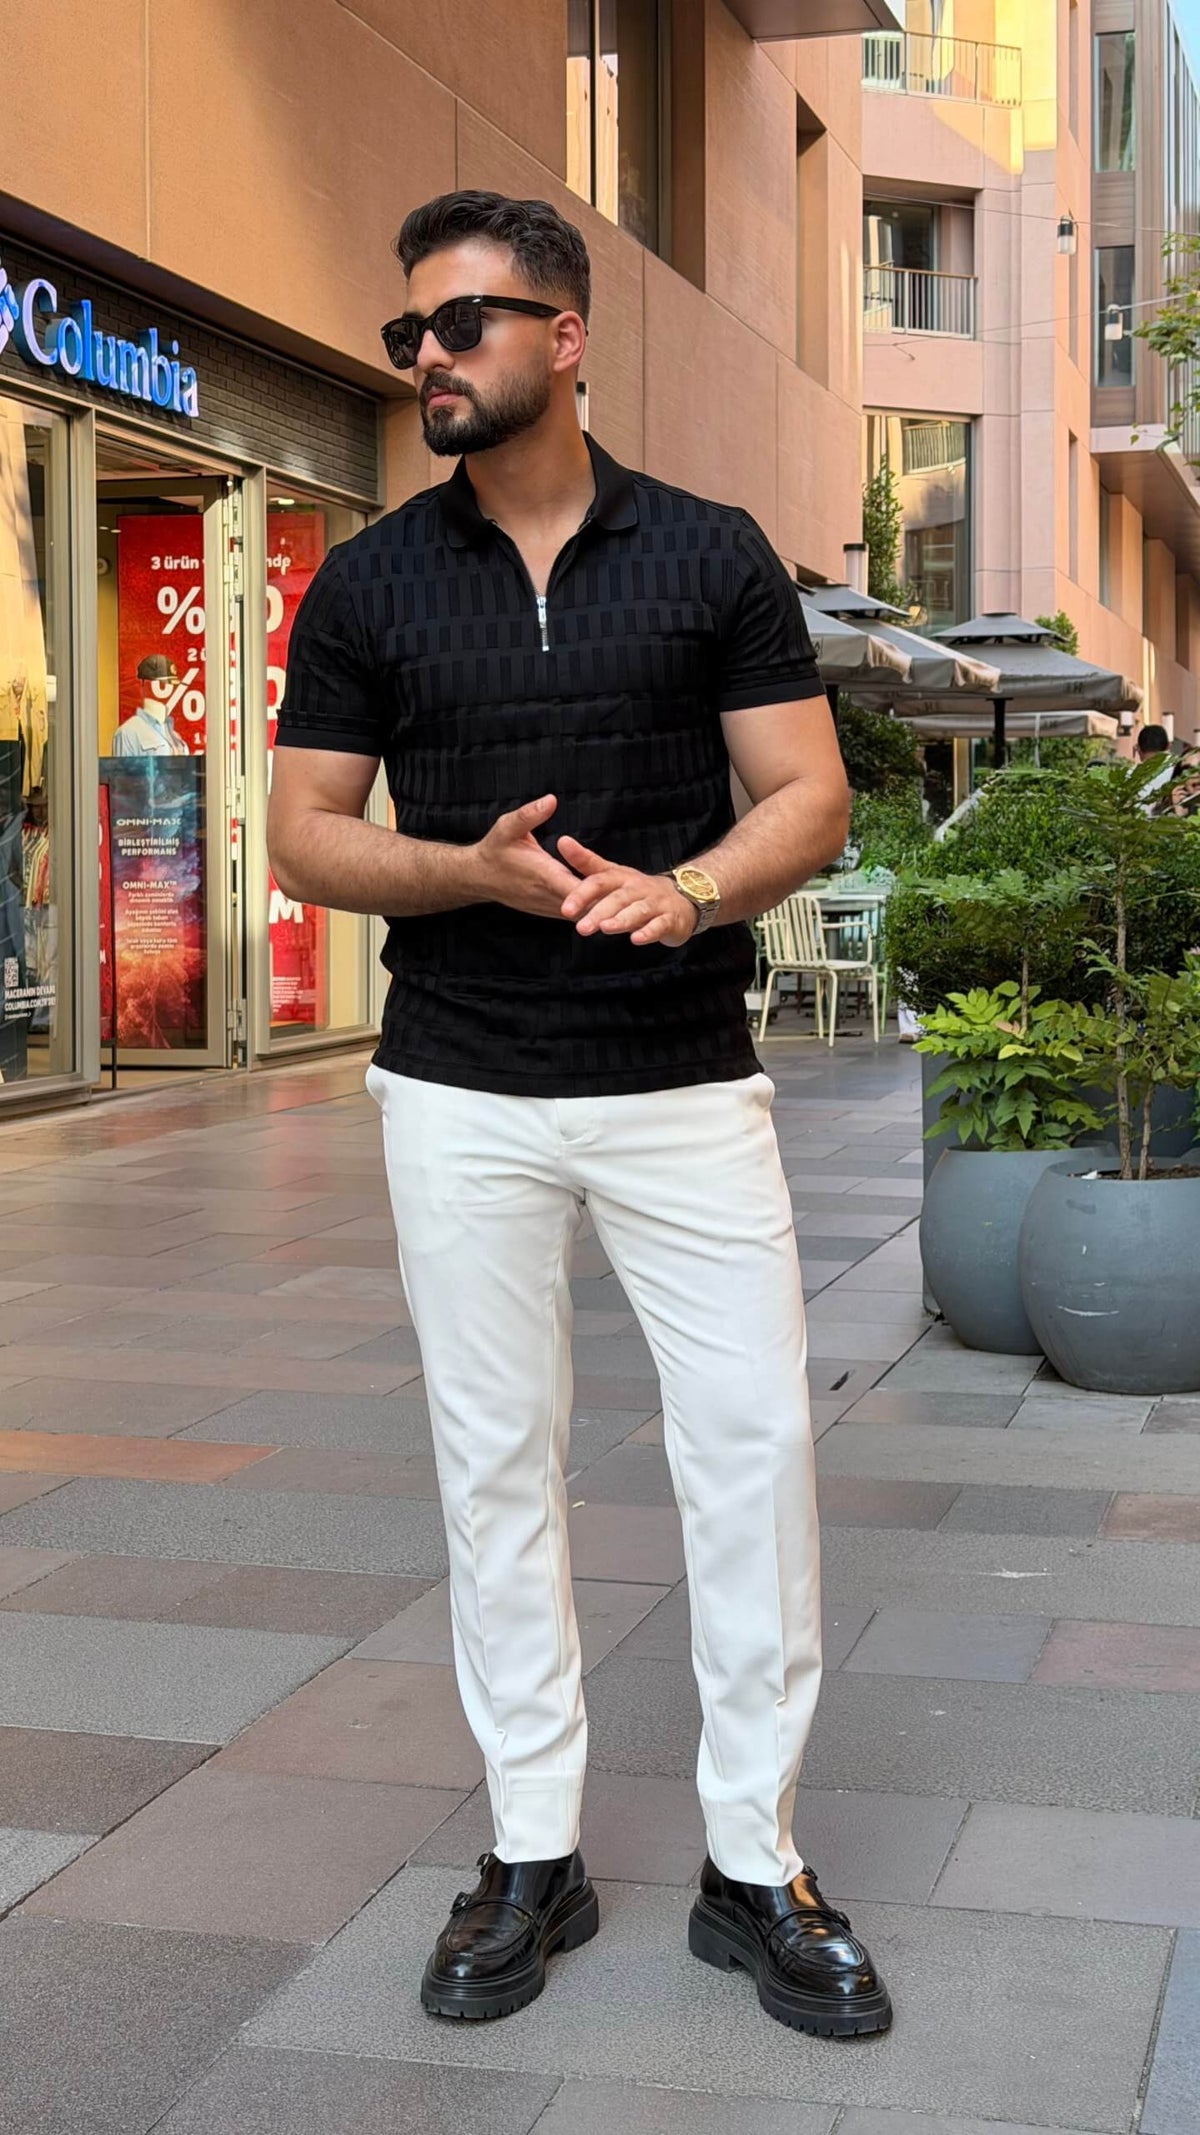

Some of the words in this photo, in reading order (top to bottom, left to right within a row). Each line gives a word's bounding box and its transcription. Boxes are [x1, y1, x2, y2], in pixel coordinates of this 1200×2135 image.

[22, 278, 199, 417] Columbia
[151, 557, 161, 570] 3
[164, 556, 200, 569] ürün
[116, 818, 182, 826] OMNI-MAX
[121, 848, 177, 856] PERFORMANS
